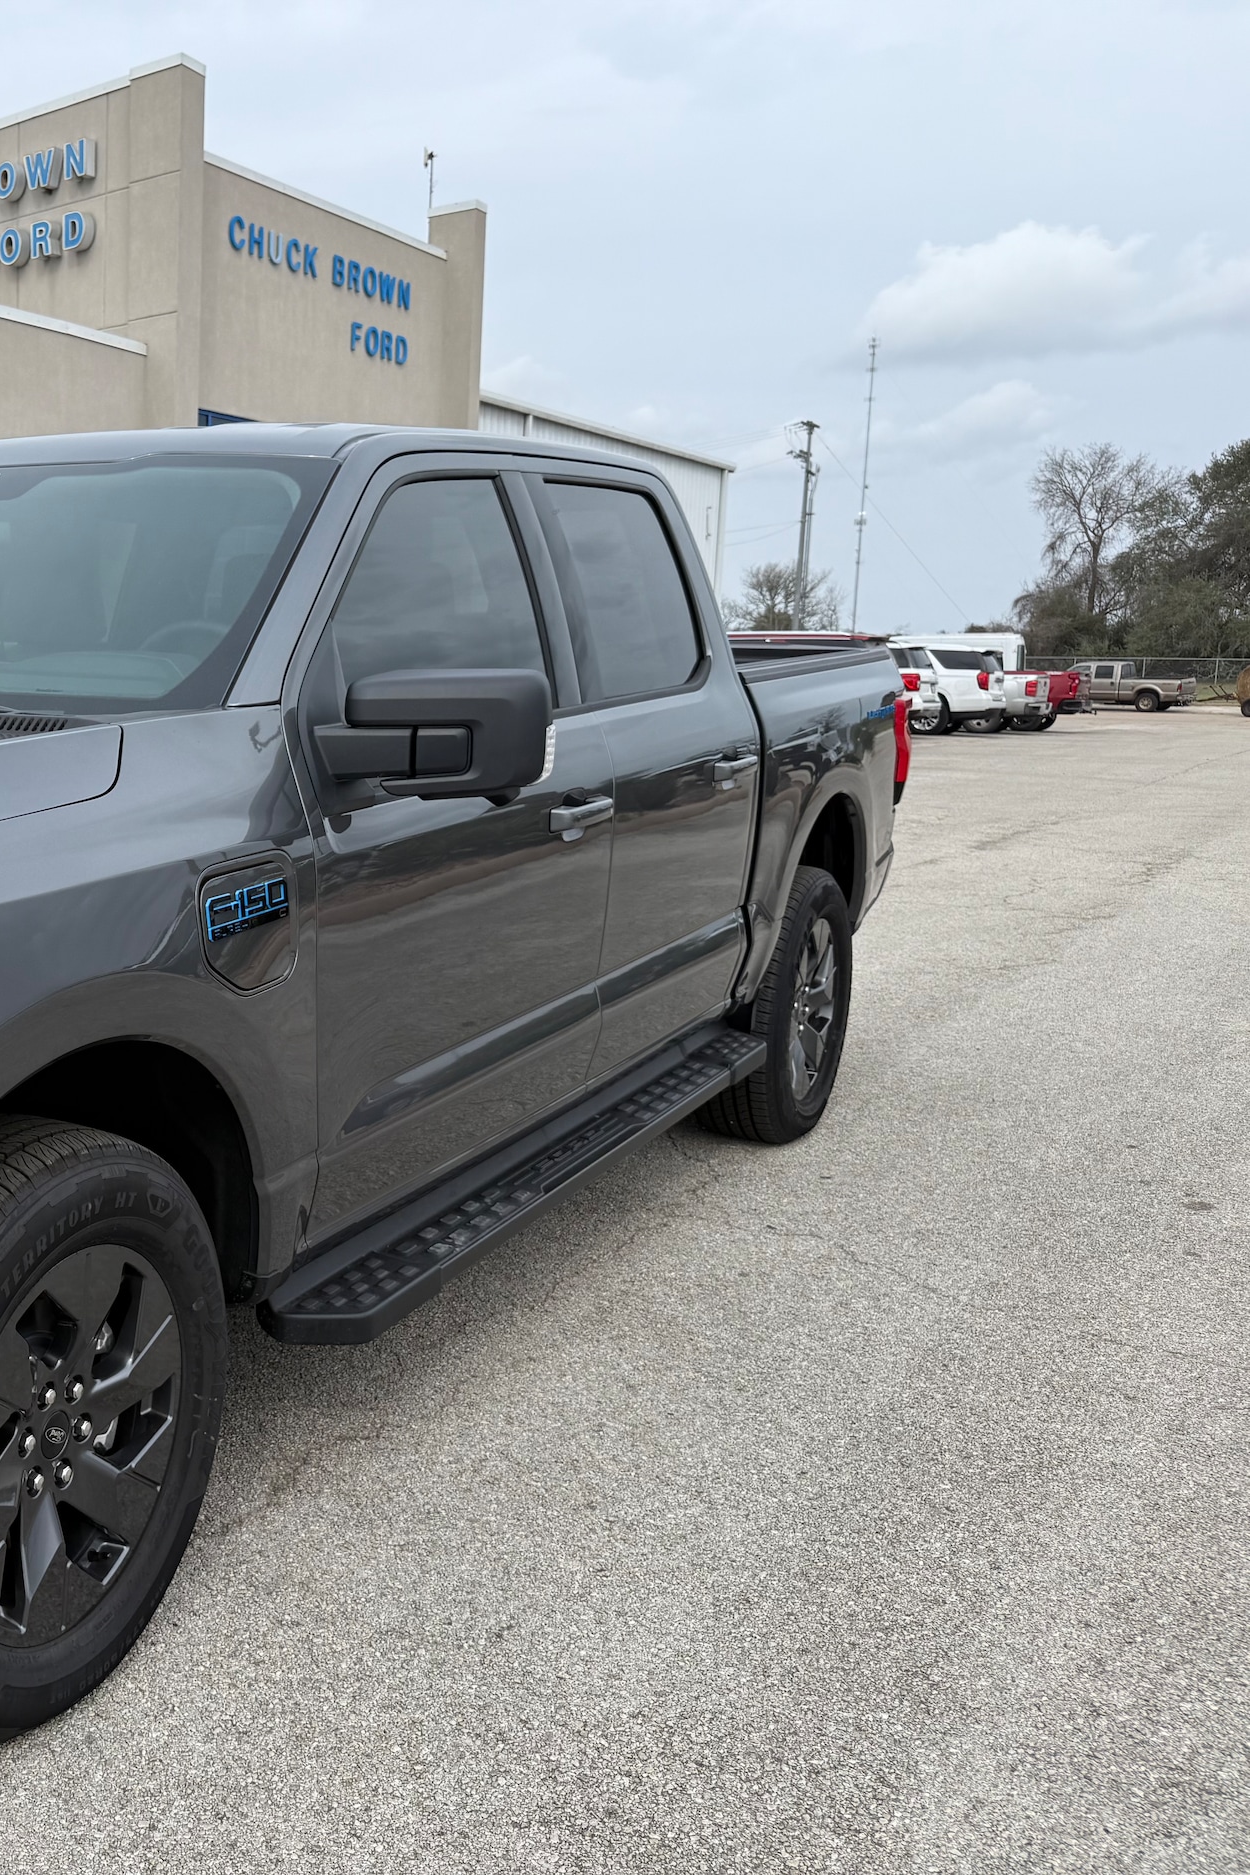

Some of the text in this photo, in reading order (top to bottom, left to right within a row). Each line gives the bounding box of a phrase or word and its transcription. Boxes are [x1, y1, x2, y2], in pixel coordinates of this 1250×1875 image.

[229, 215, 411, 311] CHUCK BROWN
[350, 321, 408, 365] FORD
[205, 877, 288, 930] F-150
[0, 1191, 139, 1300] TERRITORY HT
